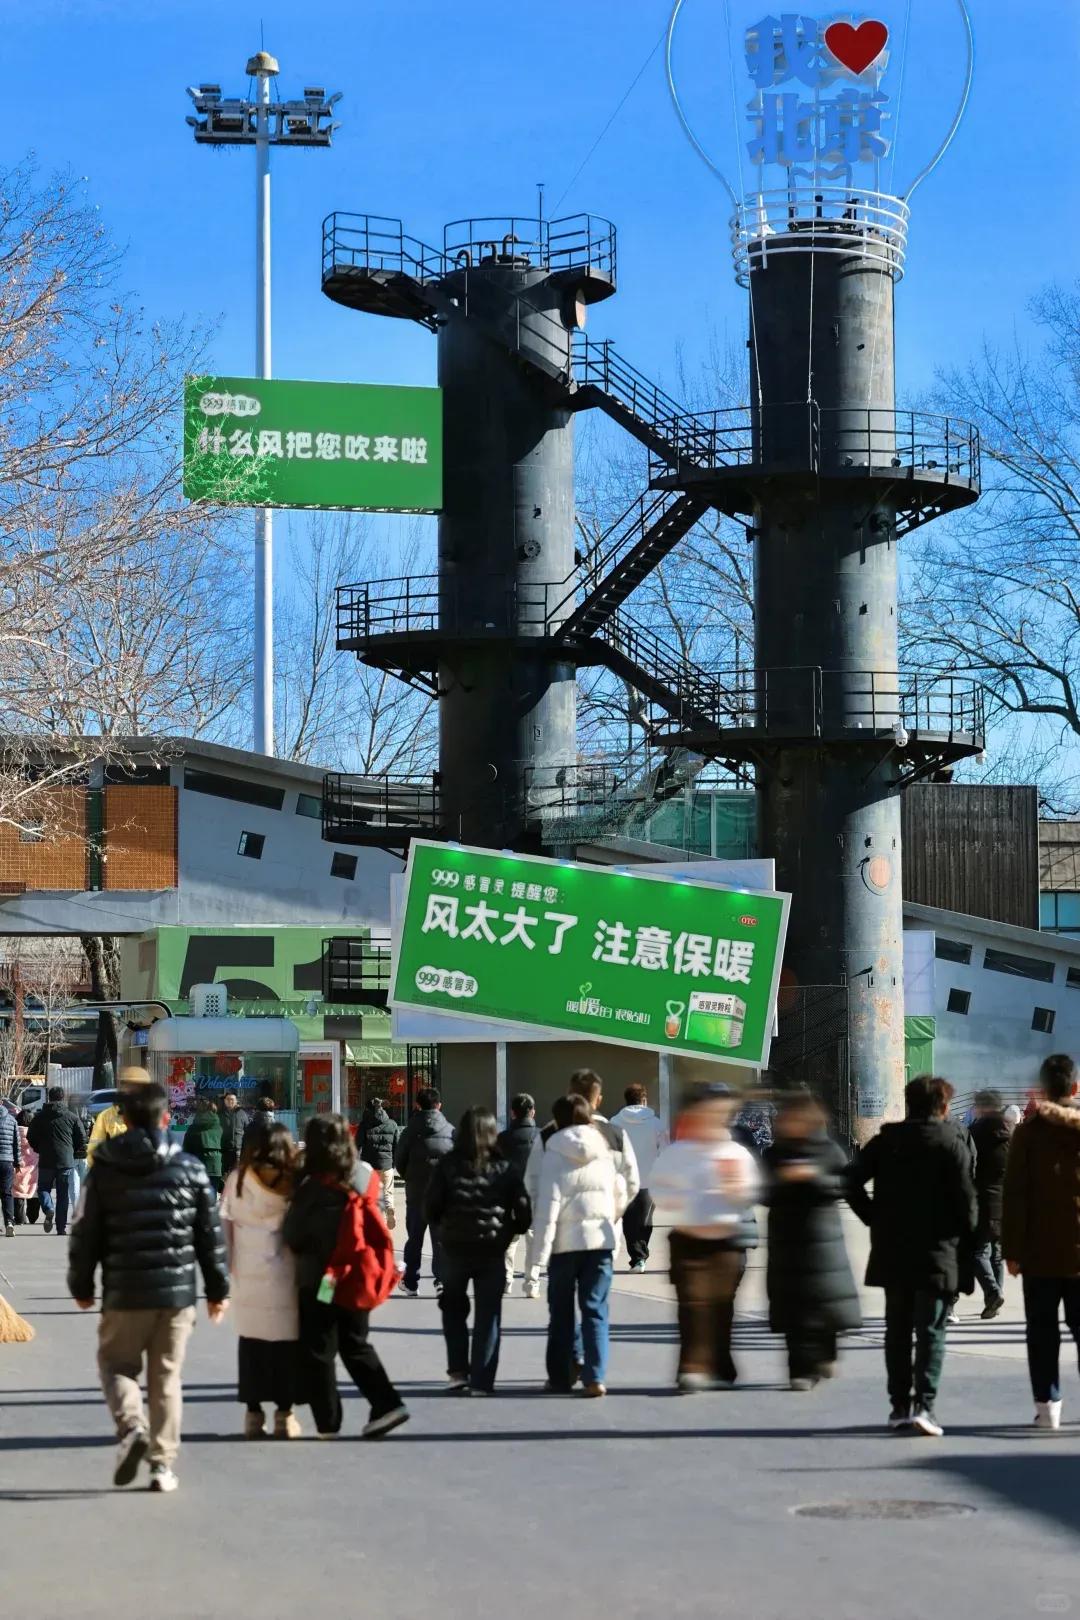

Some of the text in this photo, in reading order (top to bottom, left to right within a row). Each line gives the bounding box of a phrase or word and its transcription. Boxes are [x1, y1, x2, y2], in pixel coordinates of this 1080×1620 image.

[746, 88, 890, 164] 北京
[200, 427, 429, 464] 什么风把您吹来啦
[421, 893, 755, 985] 风太大了 注意保暖
[741, 917, 757, 926] OTC
[698, 1000, 732, 1013] 感冒灵颗粒
